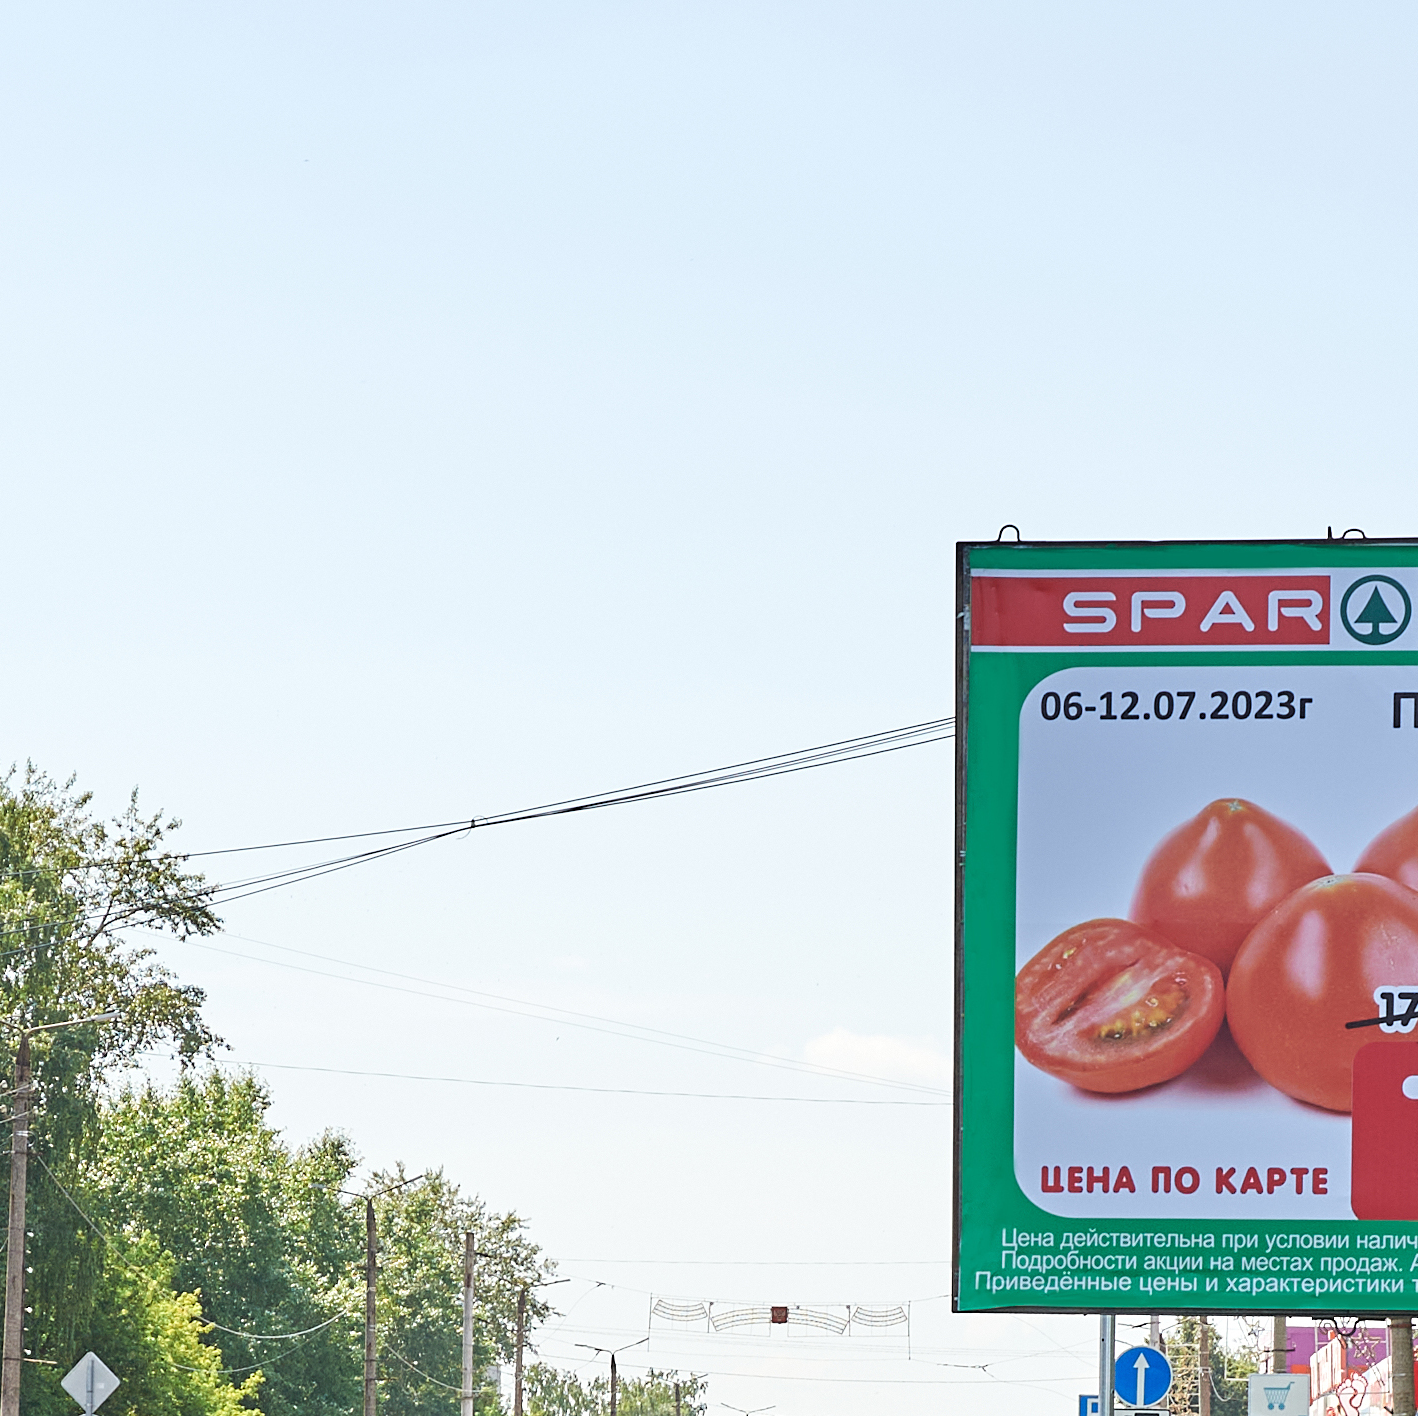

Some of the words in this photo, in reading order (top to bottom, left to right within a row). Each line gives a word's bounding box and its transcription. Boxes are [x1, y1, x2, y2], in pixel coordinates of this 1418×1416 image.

[1062, 589, 1323, 635] SPAR
[1039, 690, 1314, 722] 06-12.07.2023г
[1039, 1166, 1135, 1197] ЦЕНА
[1151, 1166, 1200, 1195] ПО
[1216, 1166, 1329, 1196] КАРТЕ
[1001, 1228, 1054, 1250] Цена
[1060, 1228, 1215, 1251] действительна
[1221, 1234, 1259, 1252] при
[1265, 1233, 1350, 1253] условии
[1000, 1250, 1137, 1273] Подробности
[1144, 1254, 1203, 1274] акции
[1210, 1256, 1234, 1271] на
[1241, 1255, 1314, 1272] местах
[1320, 1256, 1403, 1274] продаж.
[974, 1271, 1132, 1294] Приведённые
[1139, 1275, 1198, 1294] цены
[1205, 1276, 1218, 1290] и
[1225, 1276, 1404, 1296] характеристики
